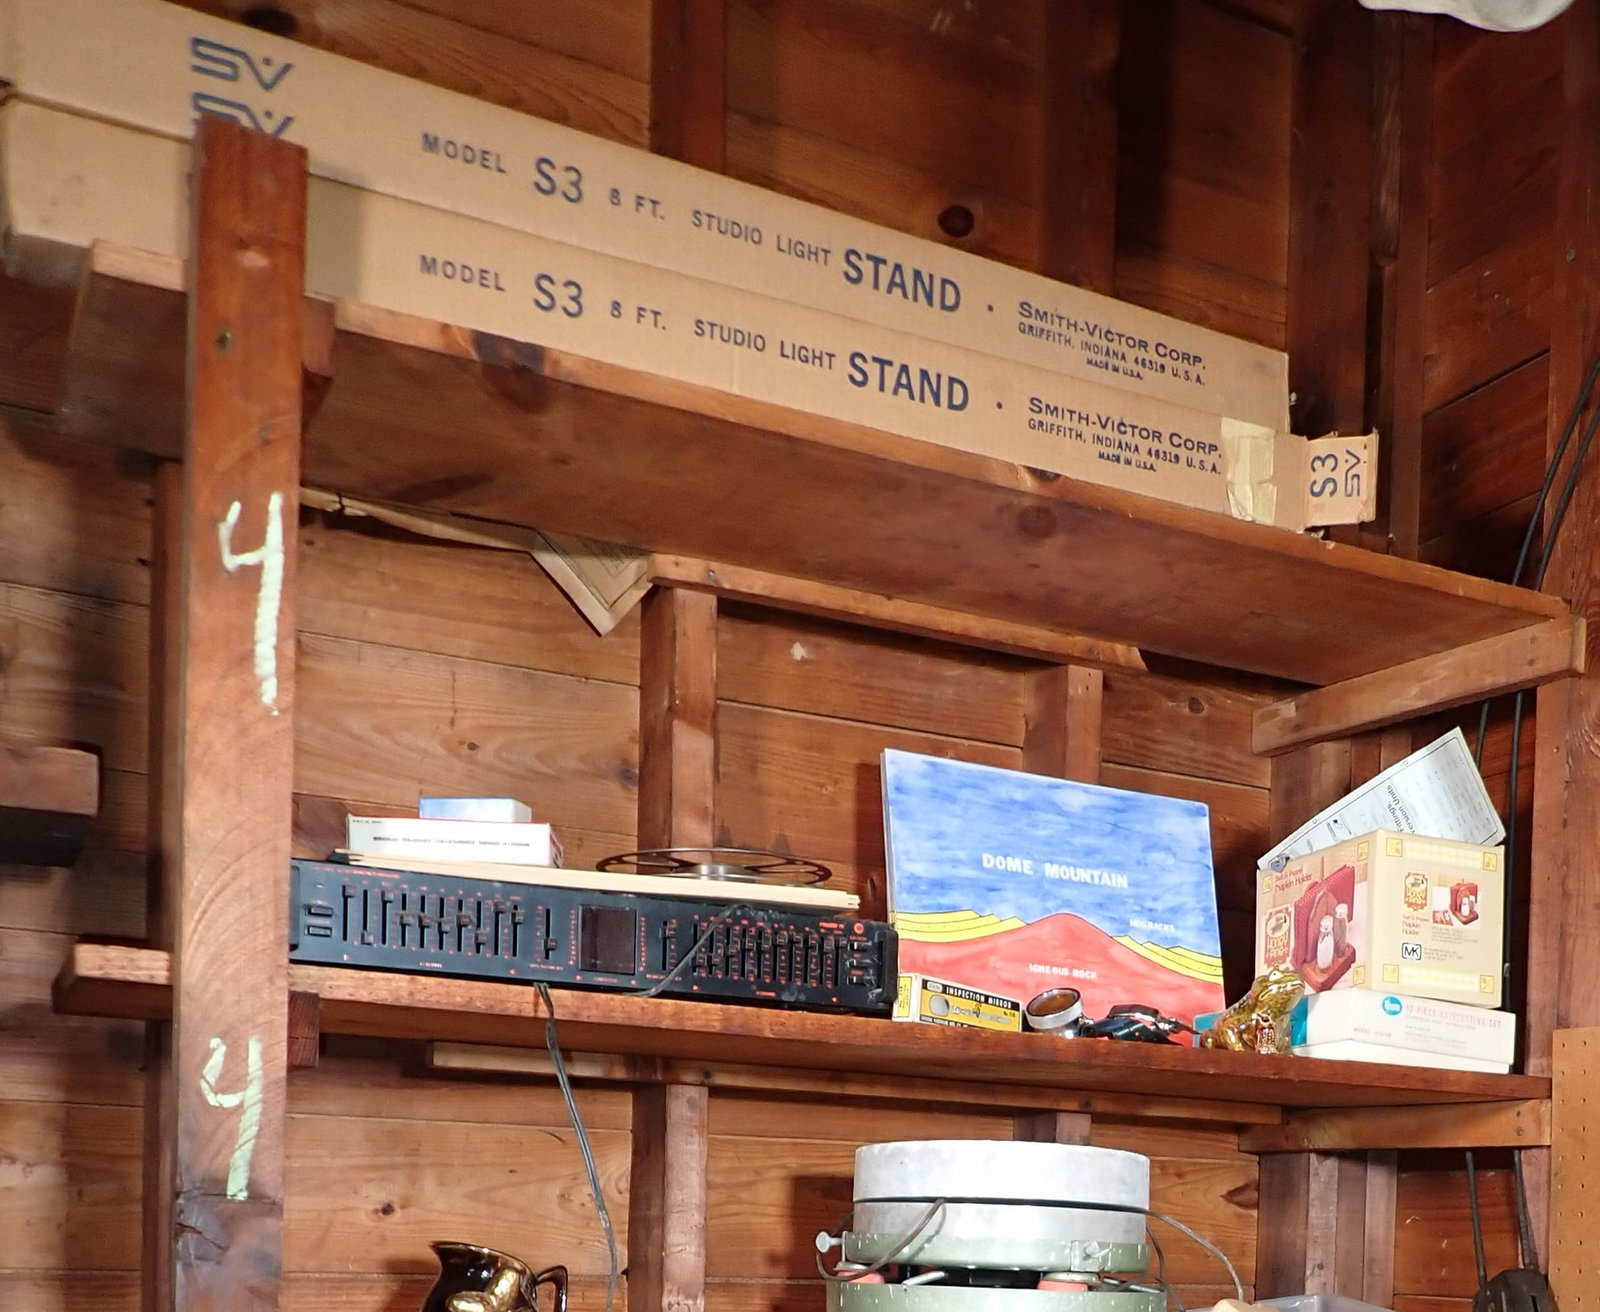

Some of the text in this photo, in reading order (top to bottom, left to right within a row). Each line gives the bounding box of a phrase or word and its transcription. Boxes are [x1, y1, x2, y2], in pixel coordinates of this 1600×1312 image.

[422, 132, 961, 313] MODEL S3 8 FT. STUDIO LIGHT STAND
[420, 253, 969, 412] MODEL S3 8 FT. STUDIO LIGHT STAND
[1018, 321, 1075, 350] GRIFFITH,
[1081, 340, 1127, 363] INDIANA
[1133, 356, 1166, 374] 46319
[1086, 357, 1109, 371] MADE
[1111, 363, 1120, 372] IN
[1028, 417, 1086, 444] GRIFFITH,
[1092, 432, 1140, 456] INDIANA
[1147, 447, 1180, 465] 46319
[1098, 450, 1120, 464] MADE
[1124, 457, 1132, 466] IN
[1309, 453, 1338, 498] S3
[218, 491, 285, 714] 4
[982, 853, 1128, 889] DOME MOUNTAIN
[1072, 968, 1098, 979] ROCK
[1404, 946, 1419, 958] MK
[946, 986, 985, 1002] INSPECTION
[988, 995, 1012, 1009] MIRROR
[200, 1033, 264, 1200] 4
